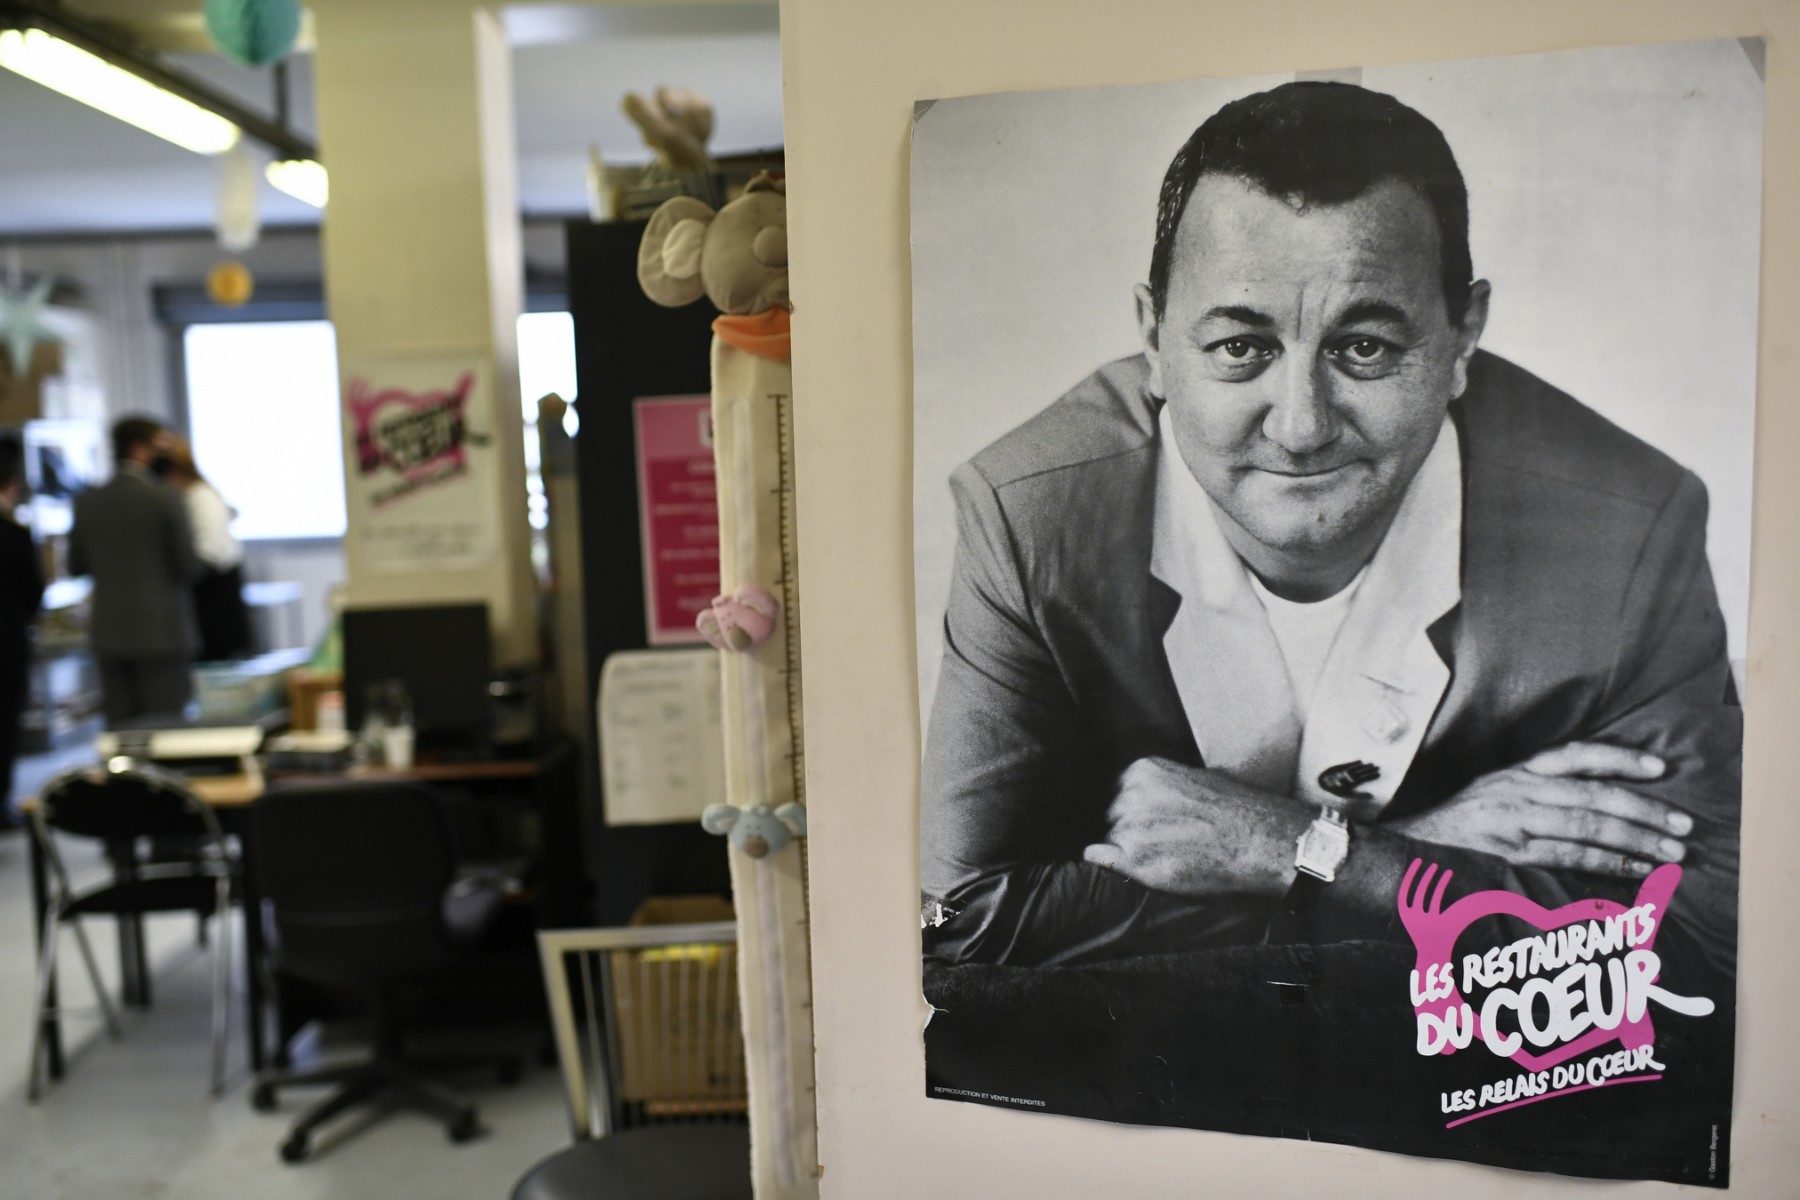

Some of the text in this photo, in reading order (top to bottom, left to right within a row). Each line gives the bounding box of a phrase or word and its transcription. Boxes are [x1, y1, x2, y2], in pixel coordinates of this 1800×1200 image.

[1410, 902, 1656, 1006] LES RESTAURANTS
[1416, 1002, 1473, 1056] DU
[934, 1086, 980, 1098] REPRODUCTION
[990, 1094, 1010, 1103] VENTE
[1010, 1097, 1046, 1107] INTERDITES
[1440, 1089, 1476, 1113] LES
[1479, 1070, 1550, 1107] RELAIS
[1552, 1063, 1585, 1089] DU
[1708, 1151, 1716, 1173] Gaston
